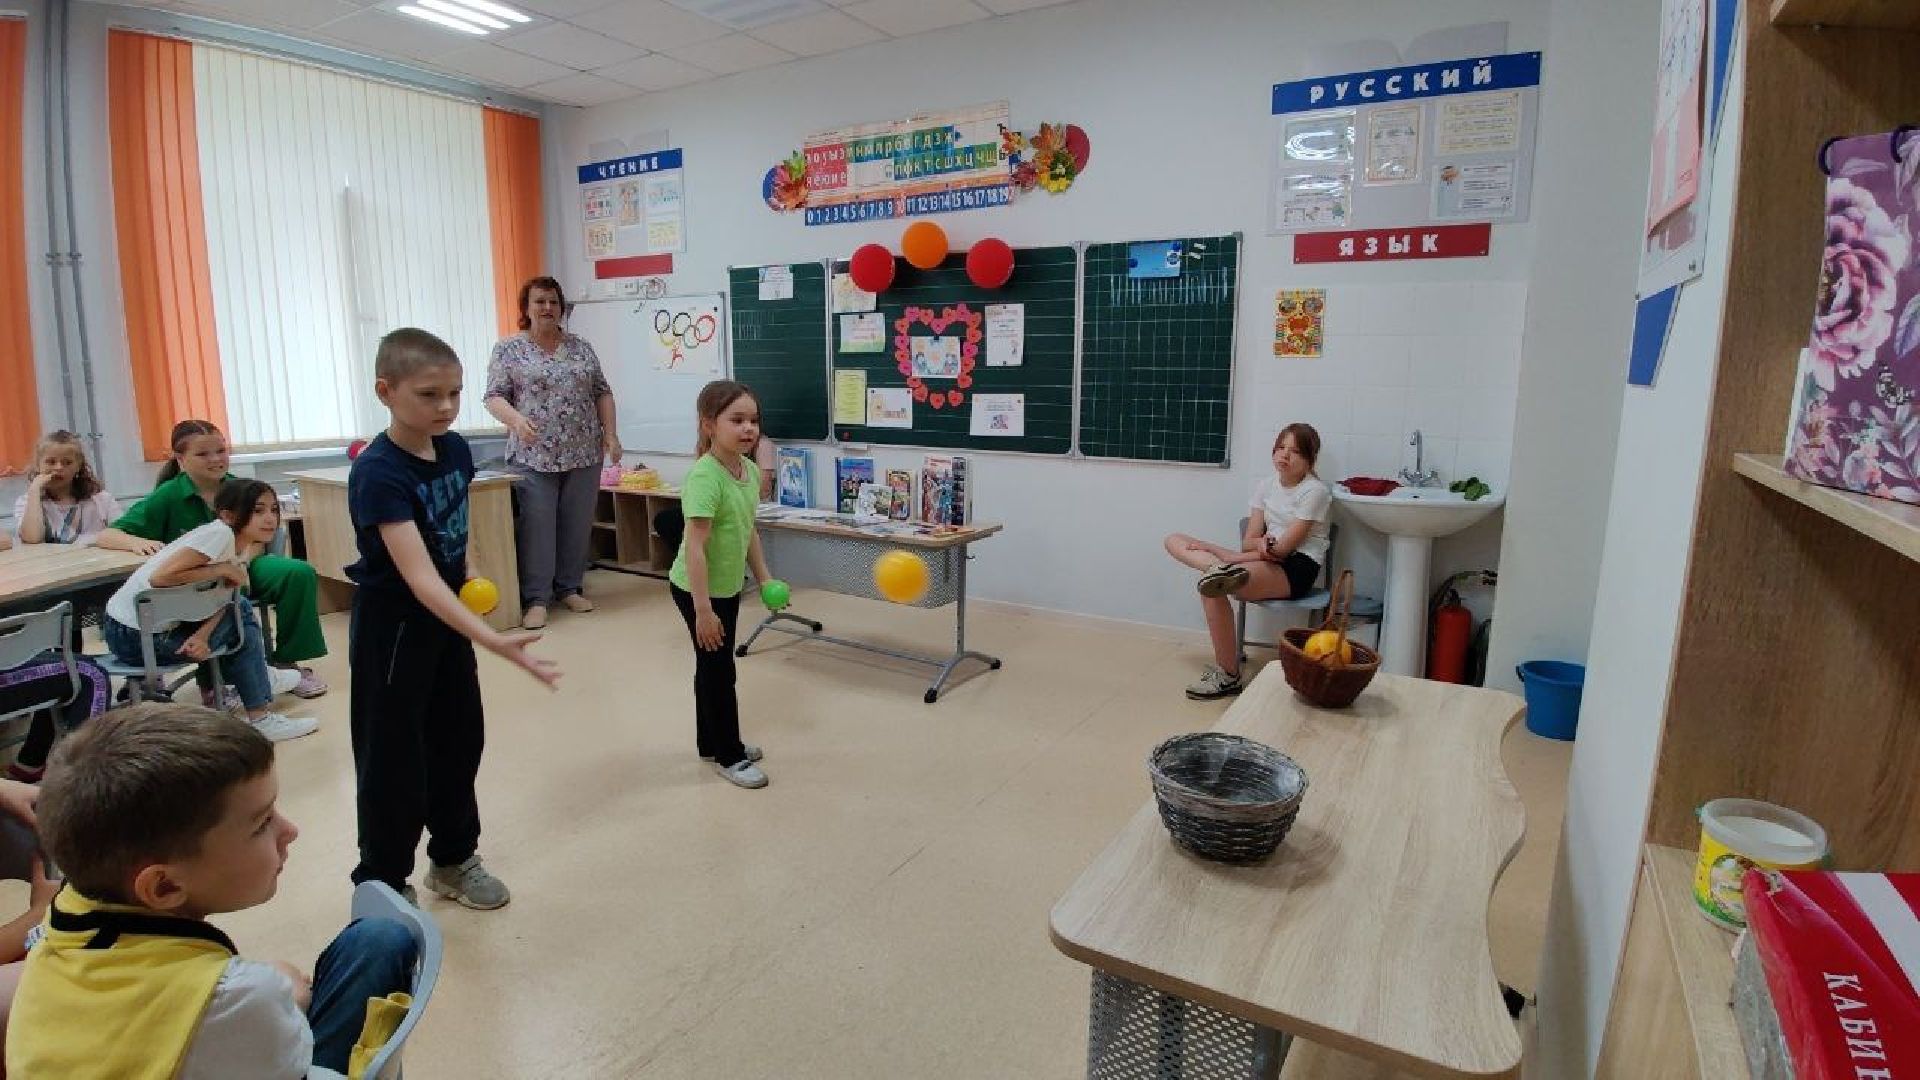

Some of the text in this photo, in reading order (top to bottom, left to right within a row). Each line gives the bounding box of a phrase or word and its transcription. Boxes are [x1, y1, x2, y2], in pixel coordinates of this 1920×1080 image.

[1310, 60, 1492, 103] РУССКИЙ
[599, 156, 658, 178] ЧТЕНИЕ
[1338, 233, 1438, 256] ЯЗЫК
